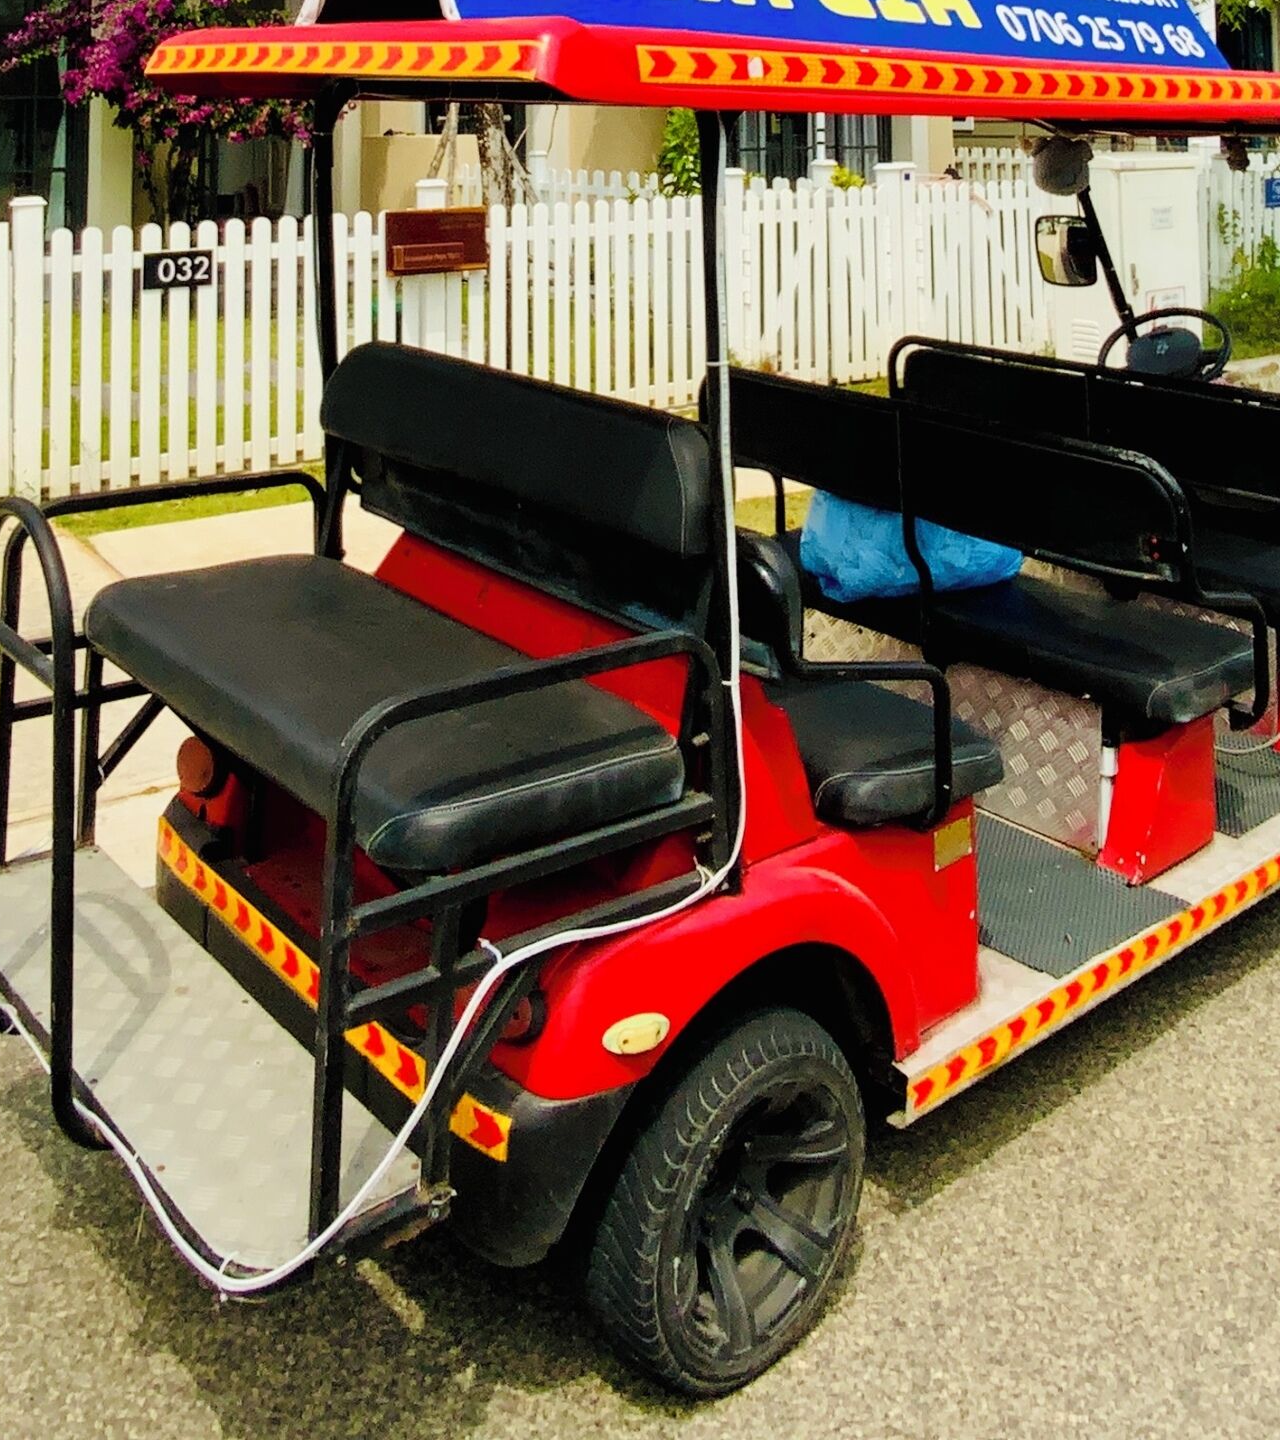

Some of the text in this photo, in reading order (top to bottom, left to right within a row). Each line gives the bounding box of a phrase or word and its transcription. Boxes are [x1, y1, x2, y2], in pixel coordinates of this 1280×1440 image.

[996, 4, 1205, 58] 0706 25 79 68
[159, 256, 210, 282] 032
